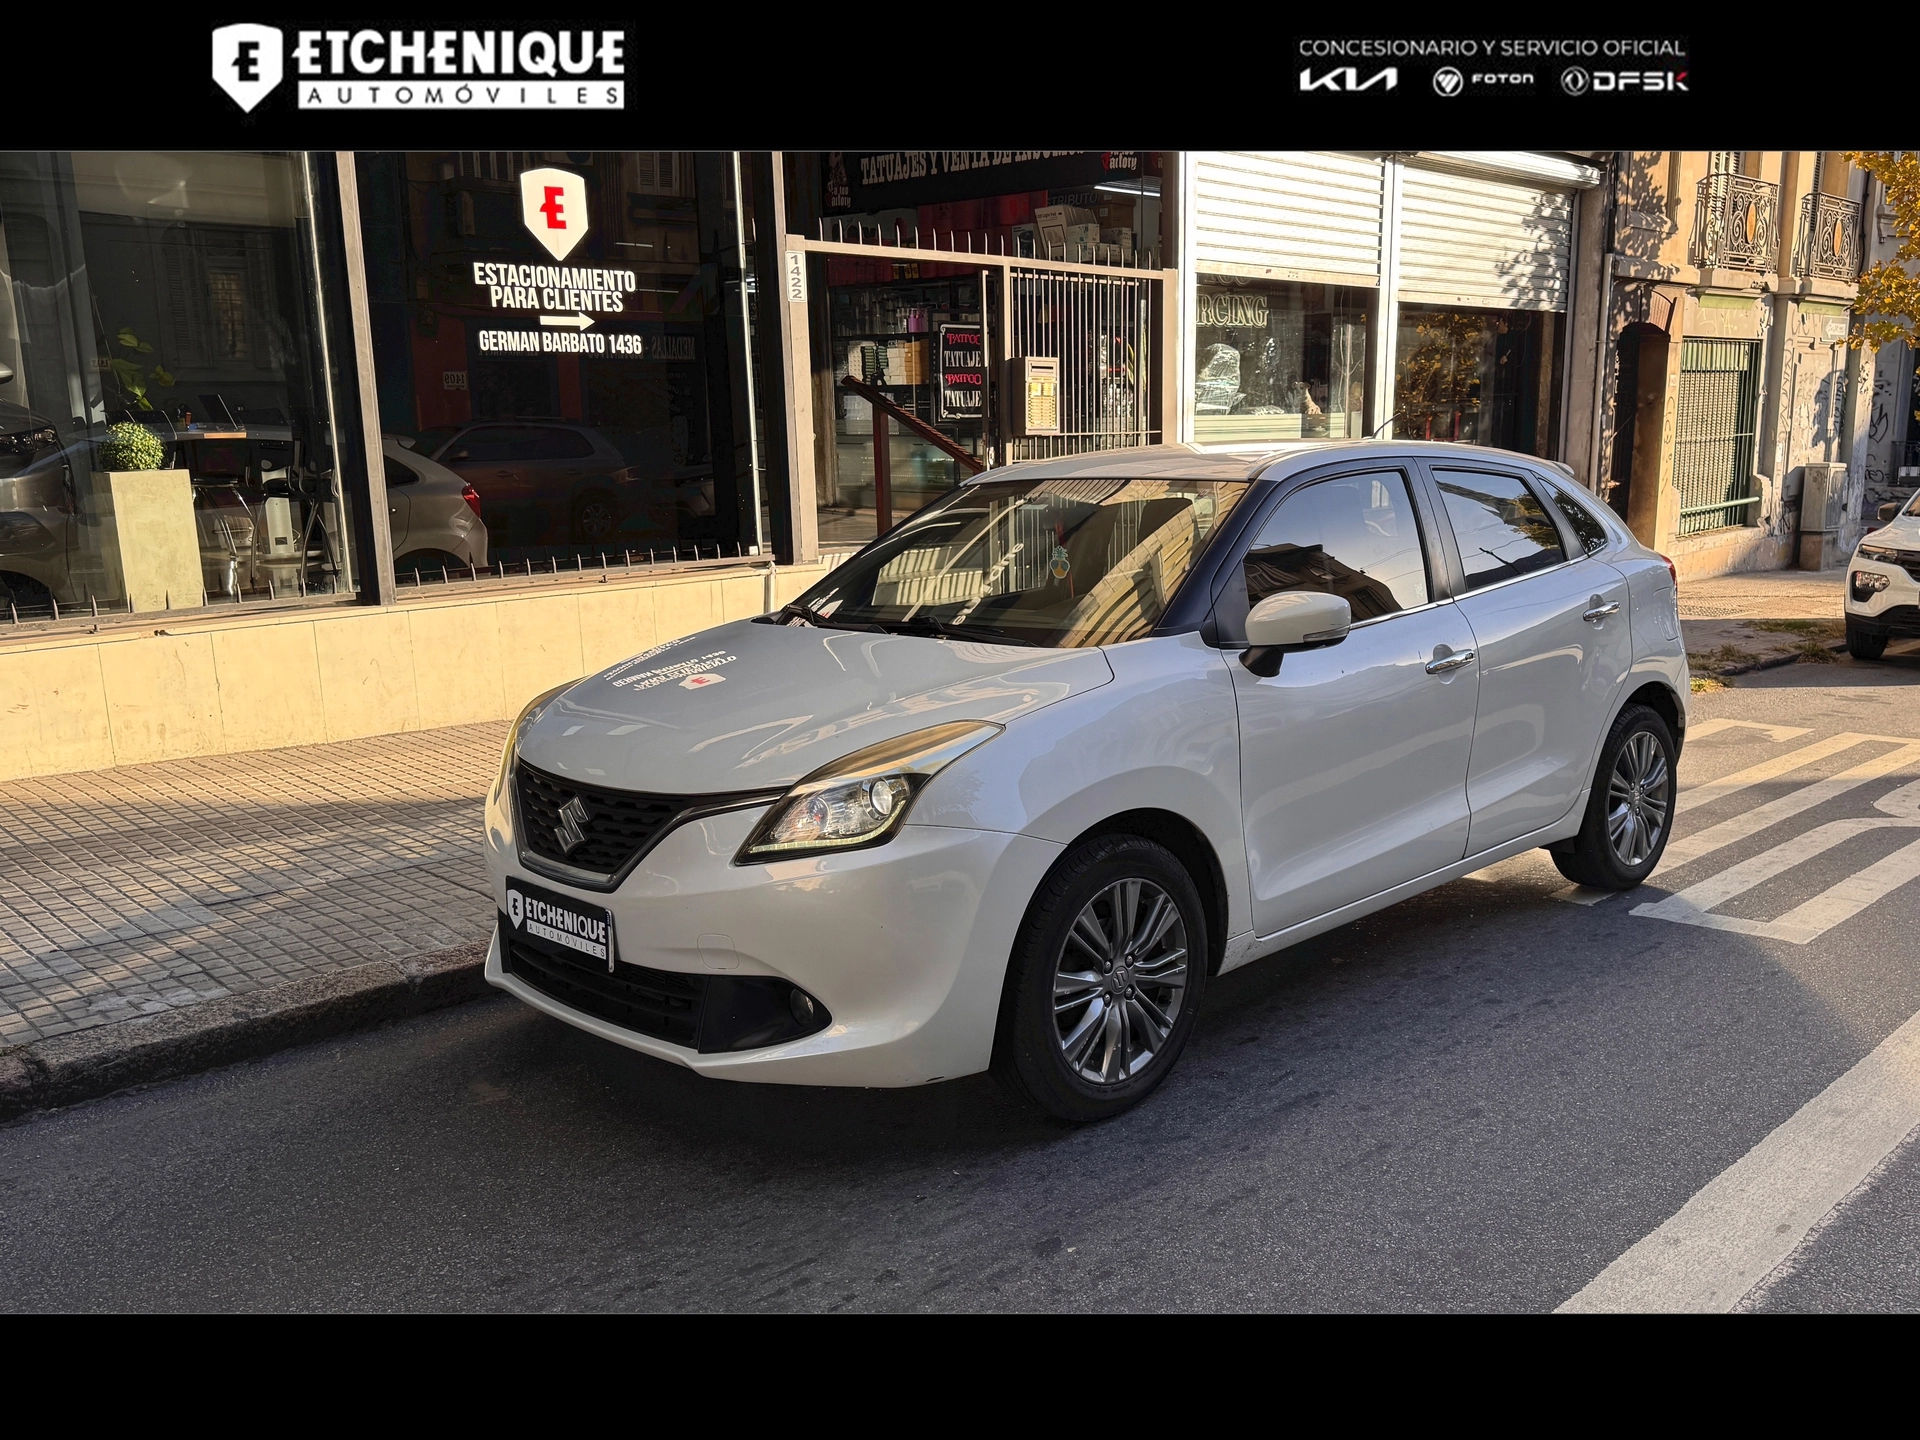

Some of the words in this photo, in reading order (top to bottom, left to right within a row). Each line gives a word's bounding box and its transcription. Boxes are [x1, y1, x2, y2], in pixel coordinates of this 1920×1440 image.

[860, 151, 926, 185] TATUAJES
[539, 185, 567, 230] E
[473, 262, 636, 293] ESTACIONAMIENTO
[790, 254, 803, 299] 1422
[490, 285, 540, 310] PARA
[543, 287, 624, 313] CLIENTES
[479, 330, 540, 352] GERMAN
[542, 331, 606, 354] BARBATO
[608, 333, 642, 355] 1436
[525, 896, 606, 944] ETCHENIQUE
[528, 922, 606, 958] AUTOMÓVILES
